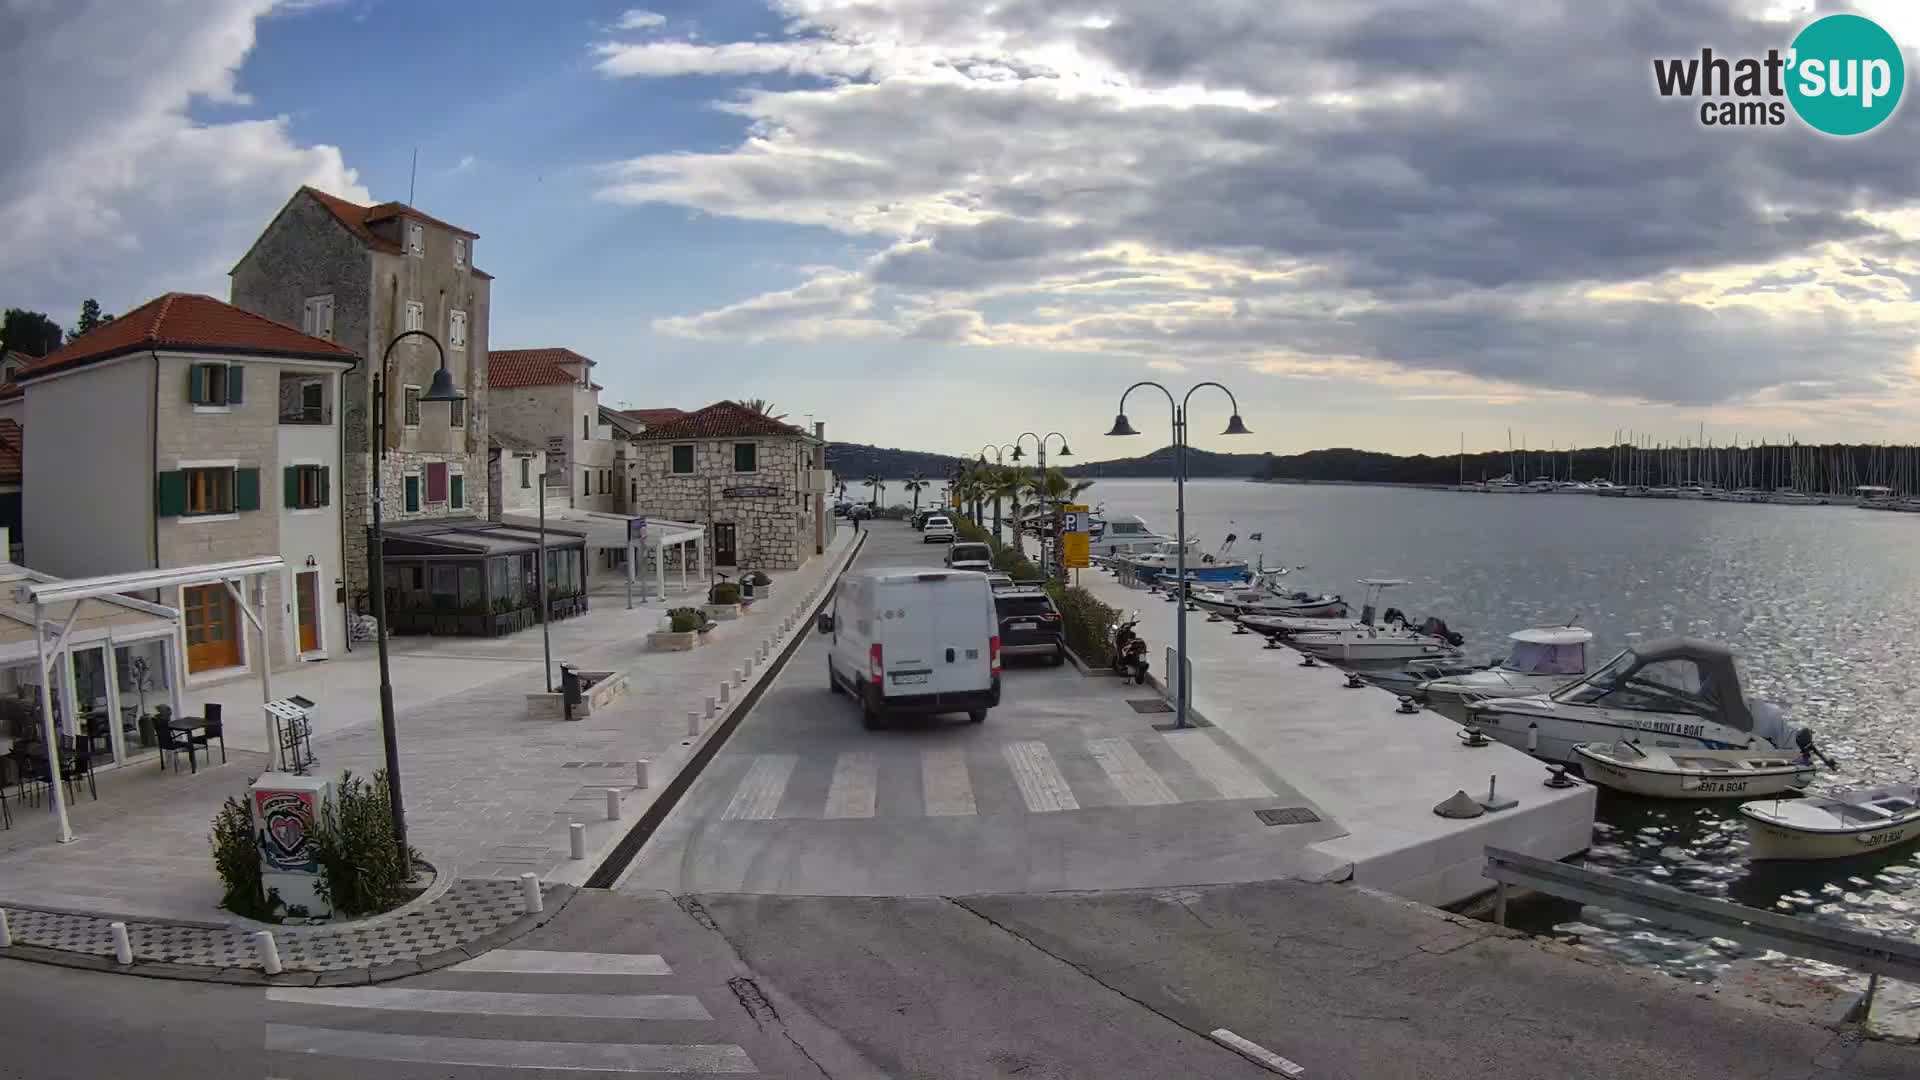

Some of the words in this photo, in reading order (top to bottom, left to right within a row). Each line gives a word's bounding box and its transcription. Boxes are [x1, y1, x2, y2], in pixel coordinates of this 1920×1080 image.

[1065, 514, 1076, 530] P
[1653, 721, 1675, 733] RENT
[1684, 723, 1704, 737] BOAT
[1718, 783, 1725, 792] A
[1726, 781, 1748, 792] BOAT
